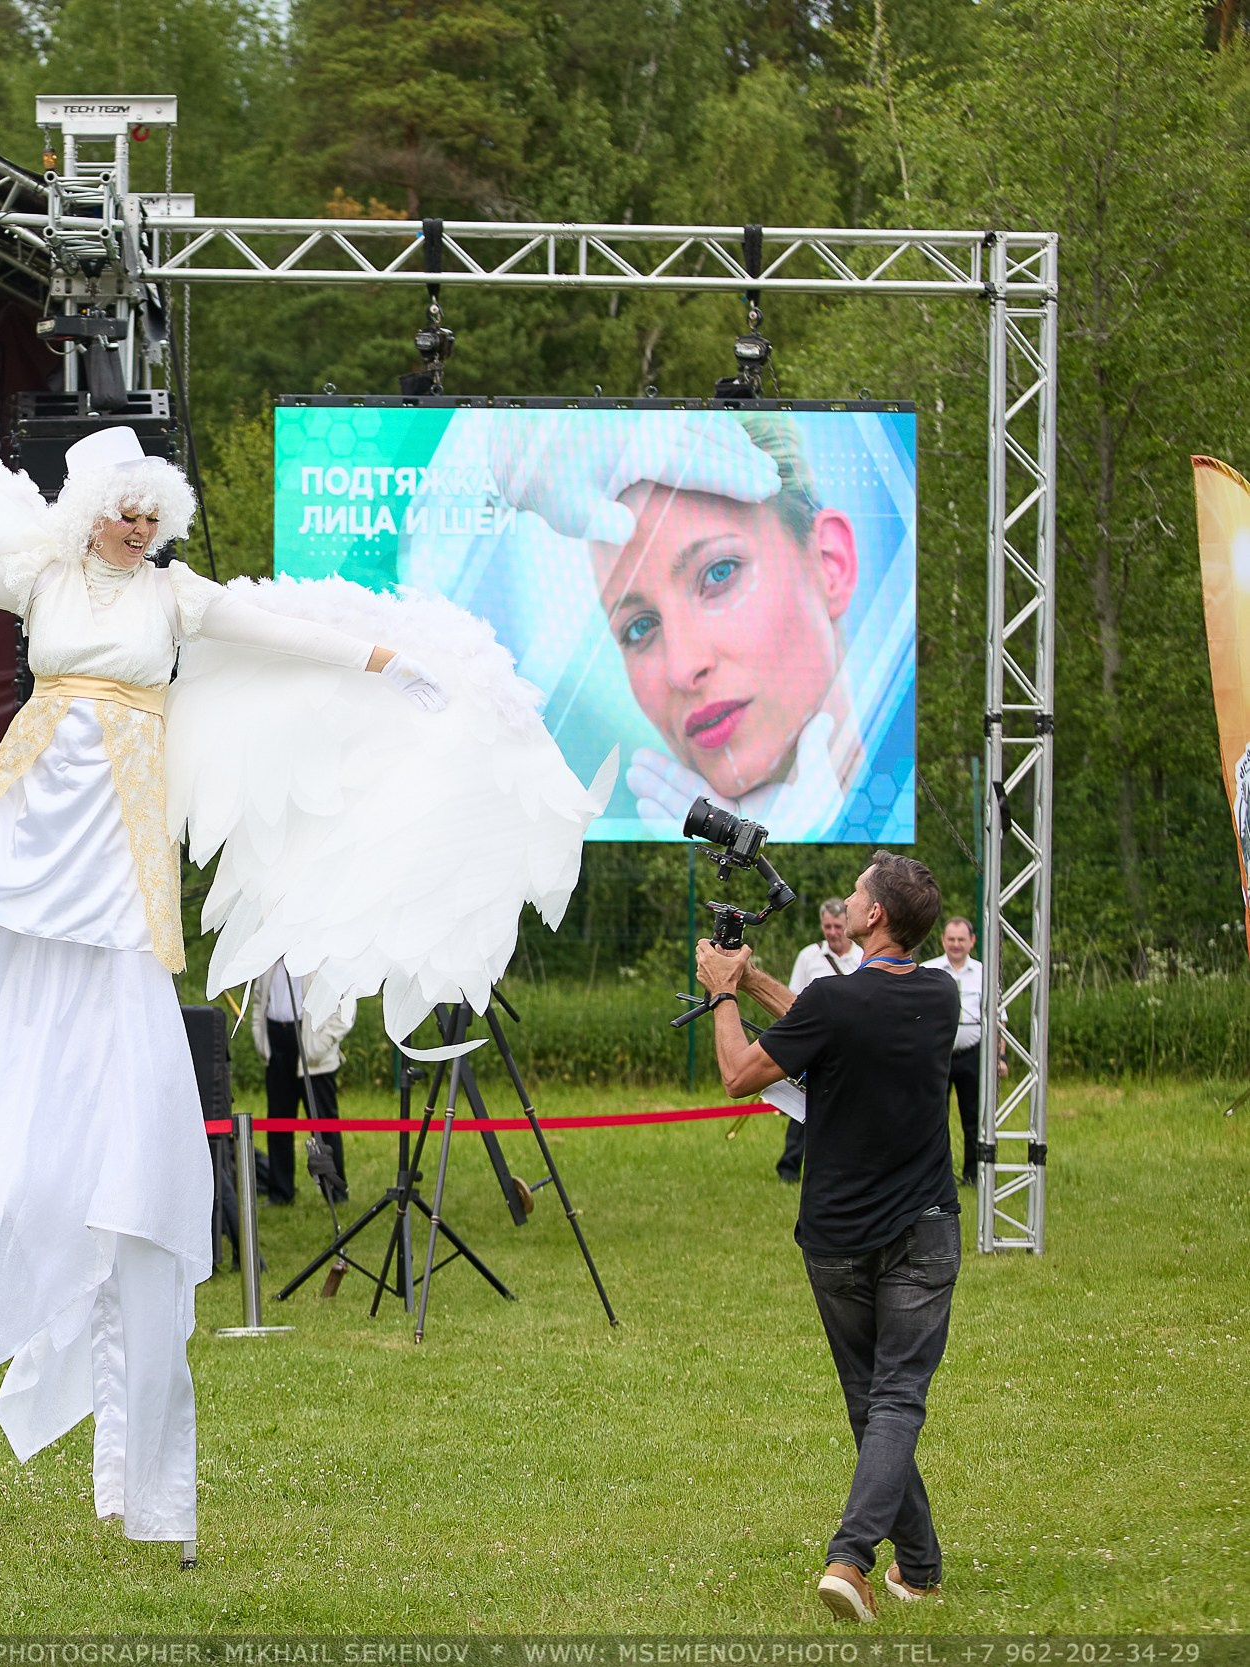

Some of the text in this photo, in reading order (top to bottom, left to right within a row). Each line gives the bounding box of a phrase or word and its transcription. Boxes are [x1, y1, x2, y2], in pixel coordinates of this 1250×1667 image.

[63, 105, 131, 114] TECH TEAM
[300, 466, 501, 502] ПОДТЯЖКА
[298, 504, 399, 541] ЛИЦА
[405, 506, 429, 536] И
